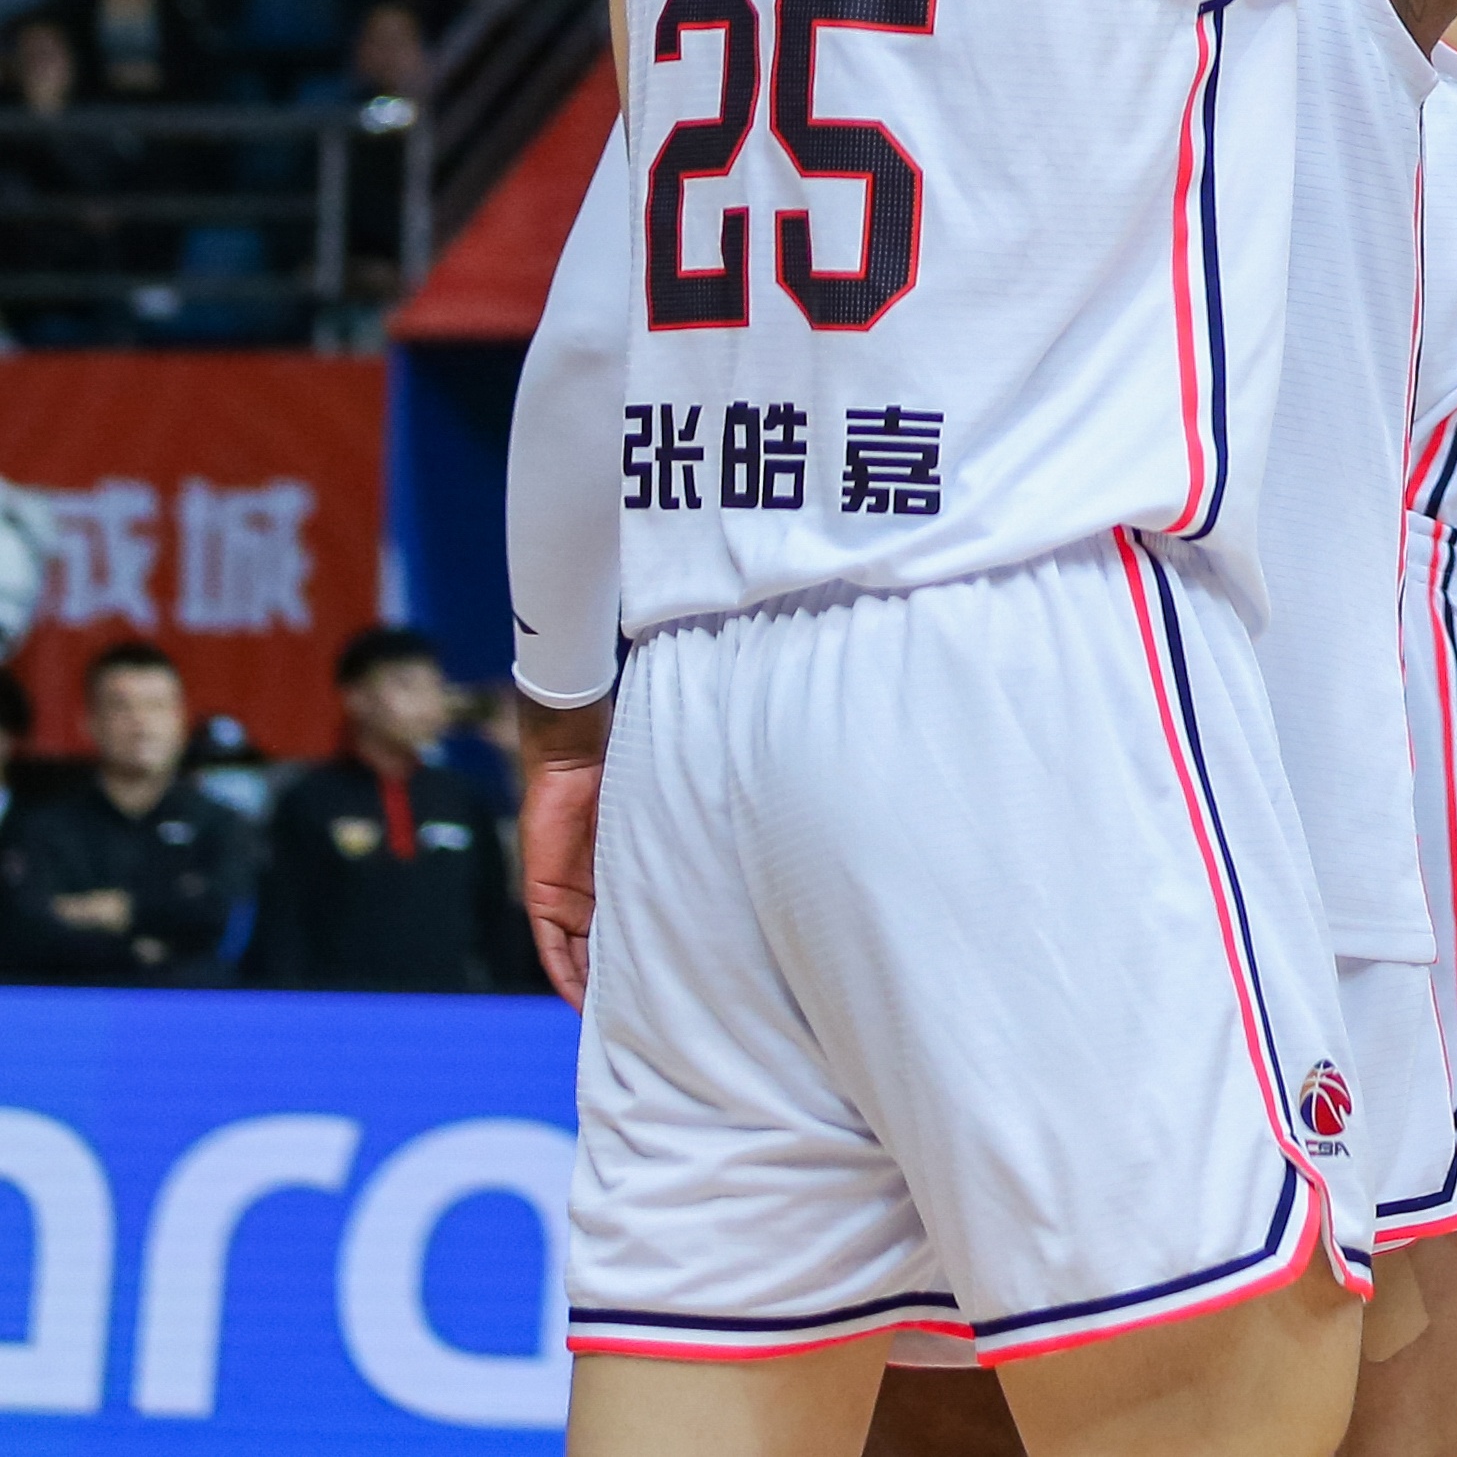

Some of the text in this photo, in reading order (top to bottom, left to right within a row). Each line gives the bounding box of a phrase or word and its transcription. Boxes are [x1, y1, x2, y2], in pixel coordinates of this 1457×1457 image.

[622, 399, 946, 516] 张皓嘉
[1305, 1140, 1350, 1158] CBA
